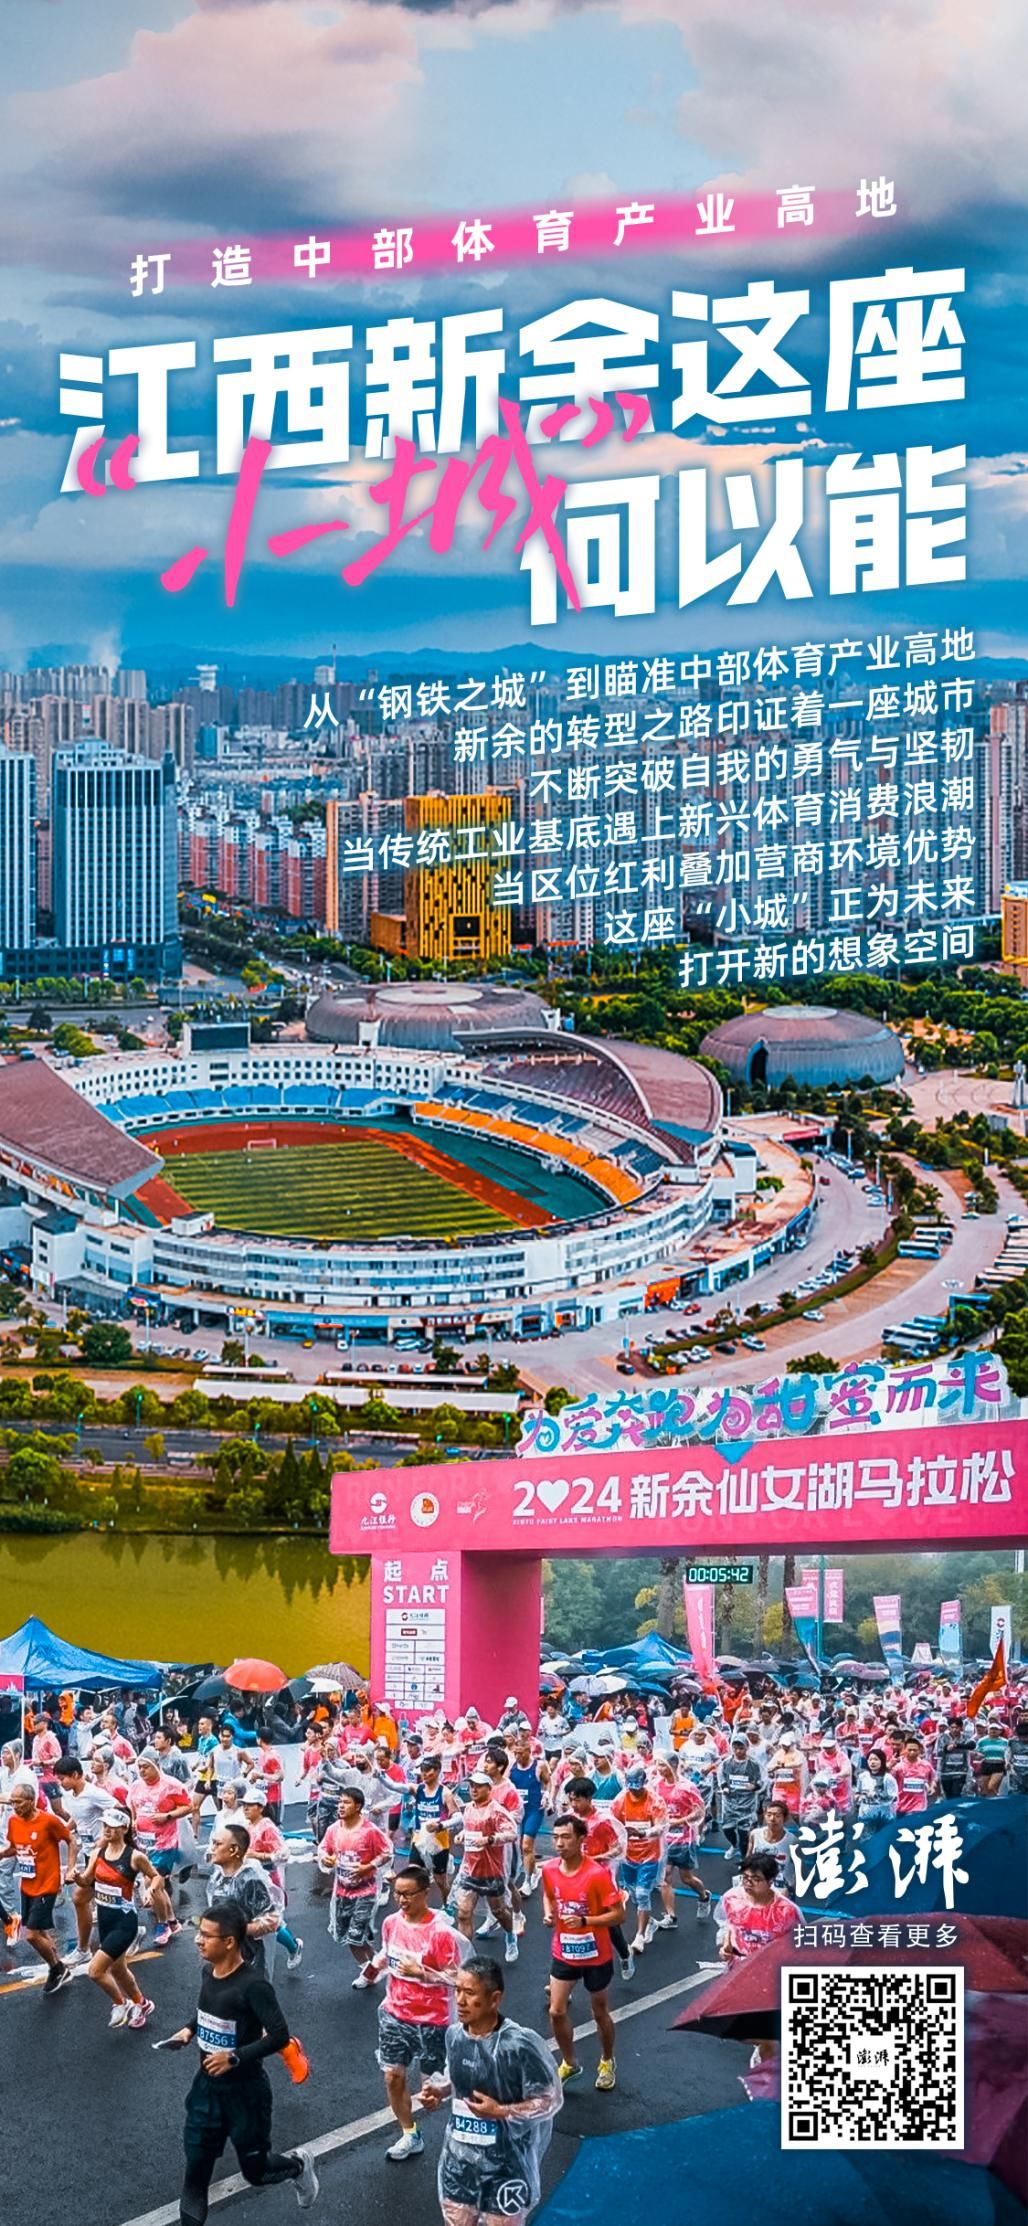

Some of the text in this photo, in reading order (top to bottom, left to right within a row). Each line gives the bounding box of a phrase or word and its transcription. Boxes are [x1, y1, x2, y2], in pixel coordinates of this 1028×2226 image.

[630, 1450, 1016, 1519] 新余仙女湖马拉松
[580, 1515, 622, 1524] MARATHON
[384, 1559, 449, 1582] 起点
[688, 1567, 750, 1583] 00:05:42
[383, 1584, 449, 1604] START
[200, 2027, 228, 2046] B7556
